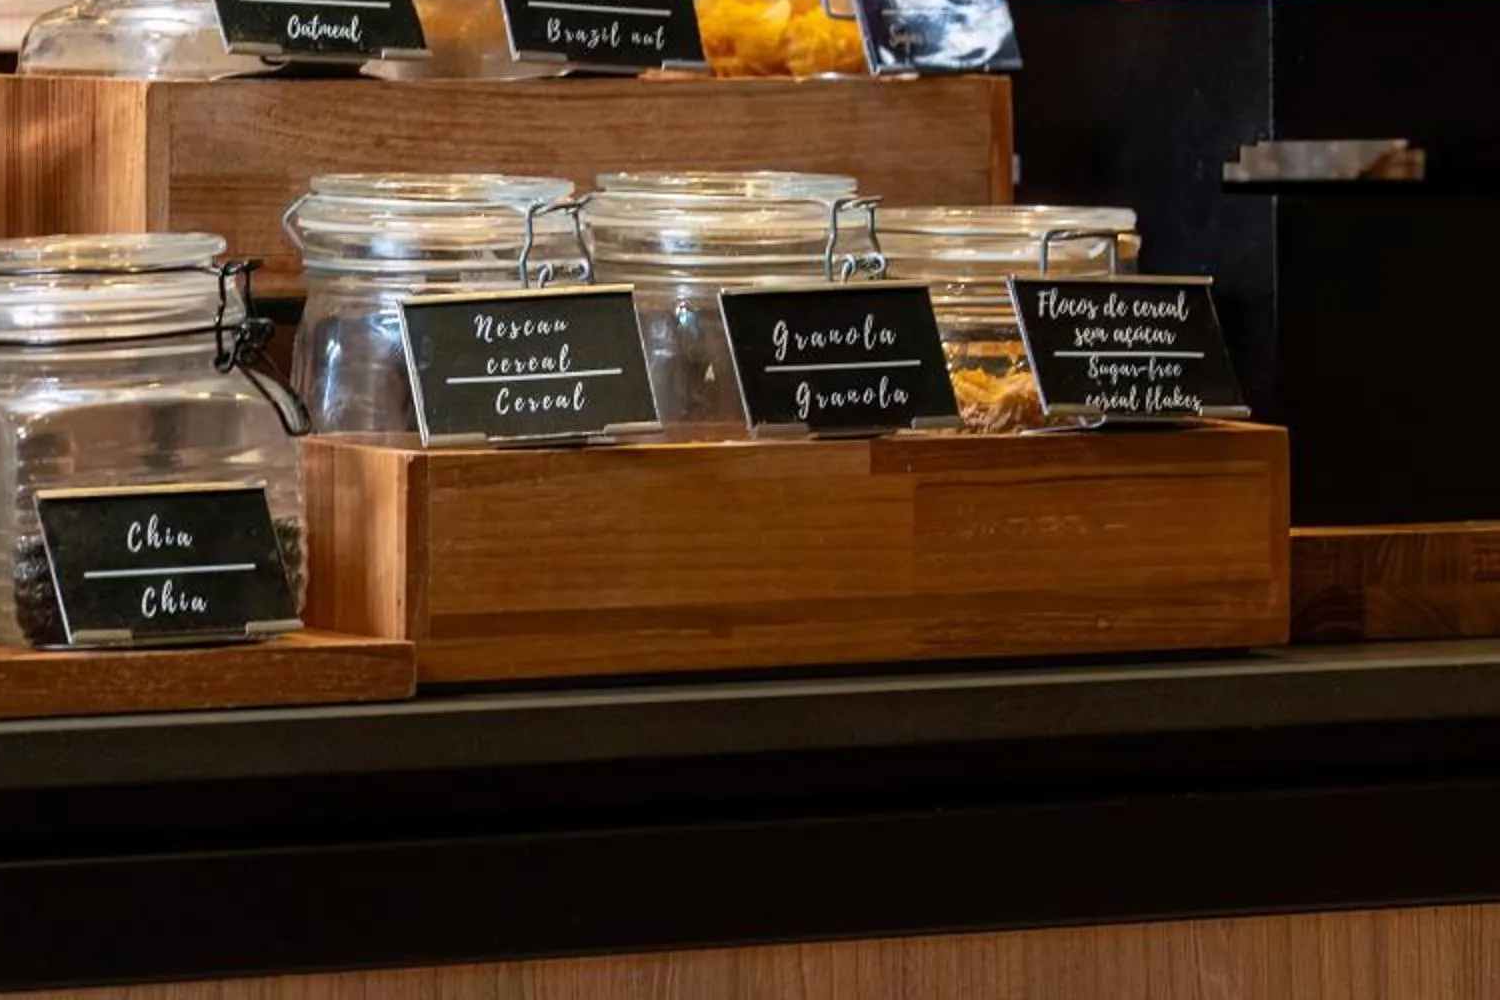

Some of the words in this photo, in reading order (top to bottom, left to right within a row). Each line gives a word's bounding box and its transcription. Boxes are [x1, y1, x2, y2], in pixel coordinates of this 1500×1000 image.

[287, 14, 363, 44] Oatmeal
[547, 17, 621, 49] Brazil
[631, 25, 666, 51] nut
[1037, 287, 1099, 320] Flocos
[1102, 291, 1130, 318] de
[1132, 290, 1190, 322] cereal
[474, 312, 568, 343] Nescau
[772, 313, 897, 361] Granola
[1074, 325, 1110, 347] sem
[486, 343, 572, 374] cereal
[1088, 356, 1183, 385] Sugar-free
[495, 381, 586, 415] Cereal
[795, 375, 909, 420] Granola
[127, 513, 193, 552] Chia
[141, 579, 208, 618] Chia
